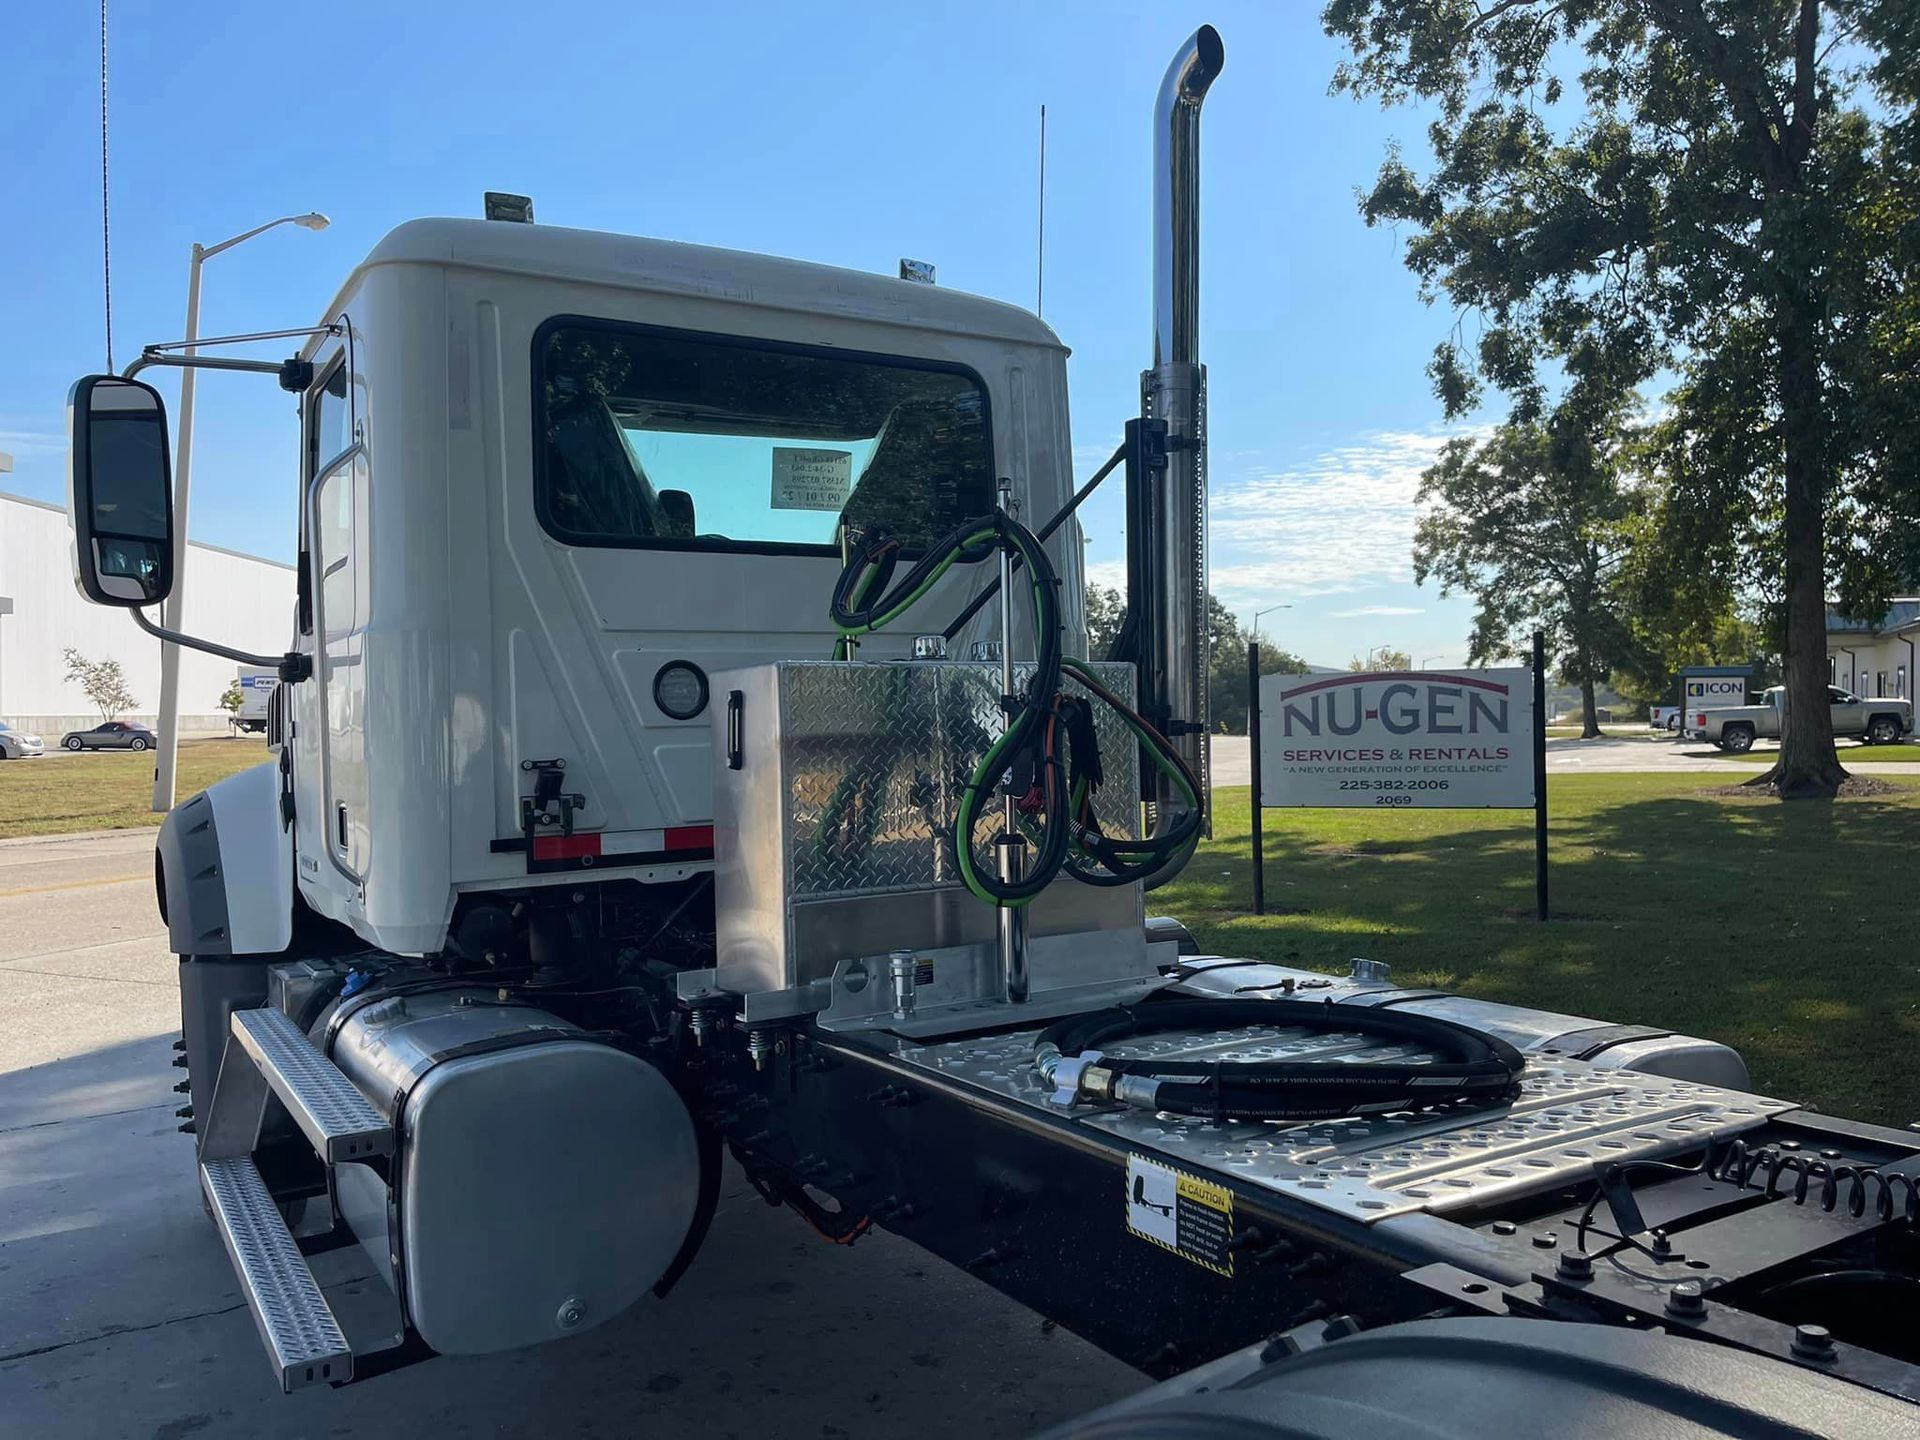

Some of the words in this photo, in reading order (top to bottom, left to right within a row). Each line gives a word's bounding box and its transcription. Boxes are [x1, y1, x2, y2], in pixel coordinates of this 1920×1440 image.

[1706, 682, 1742, 693] ICON
[1283, 683, 1509, 737] NU-GEN
[1283, 748, 1384, 762] SERVICES
[1389, 749, 1404, 761] &
[1409, 747, 1509, 761] RENTALS
[1298, 766, 1326, 774] NEW
[1328, 765, 1402, 774] GENERATION
[1406, 765, 1421, 773] OF
[1339, 779, 1449, 791] 225-382-2006
[1376, 795, 1412, 805] 2069
[1188, 1185, 1225, 1206] CAUTION
